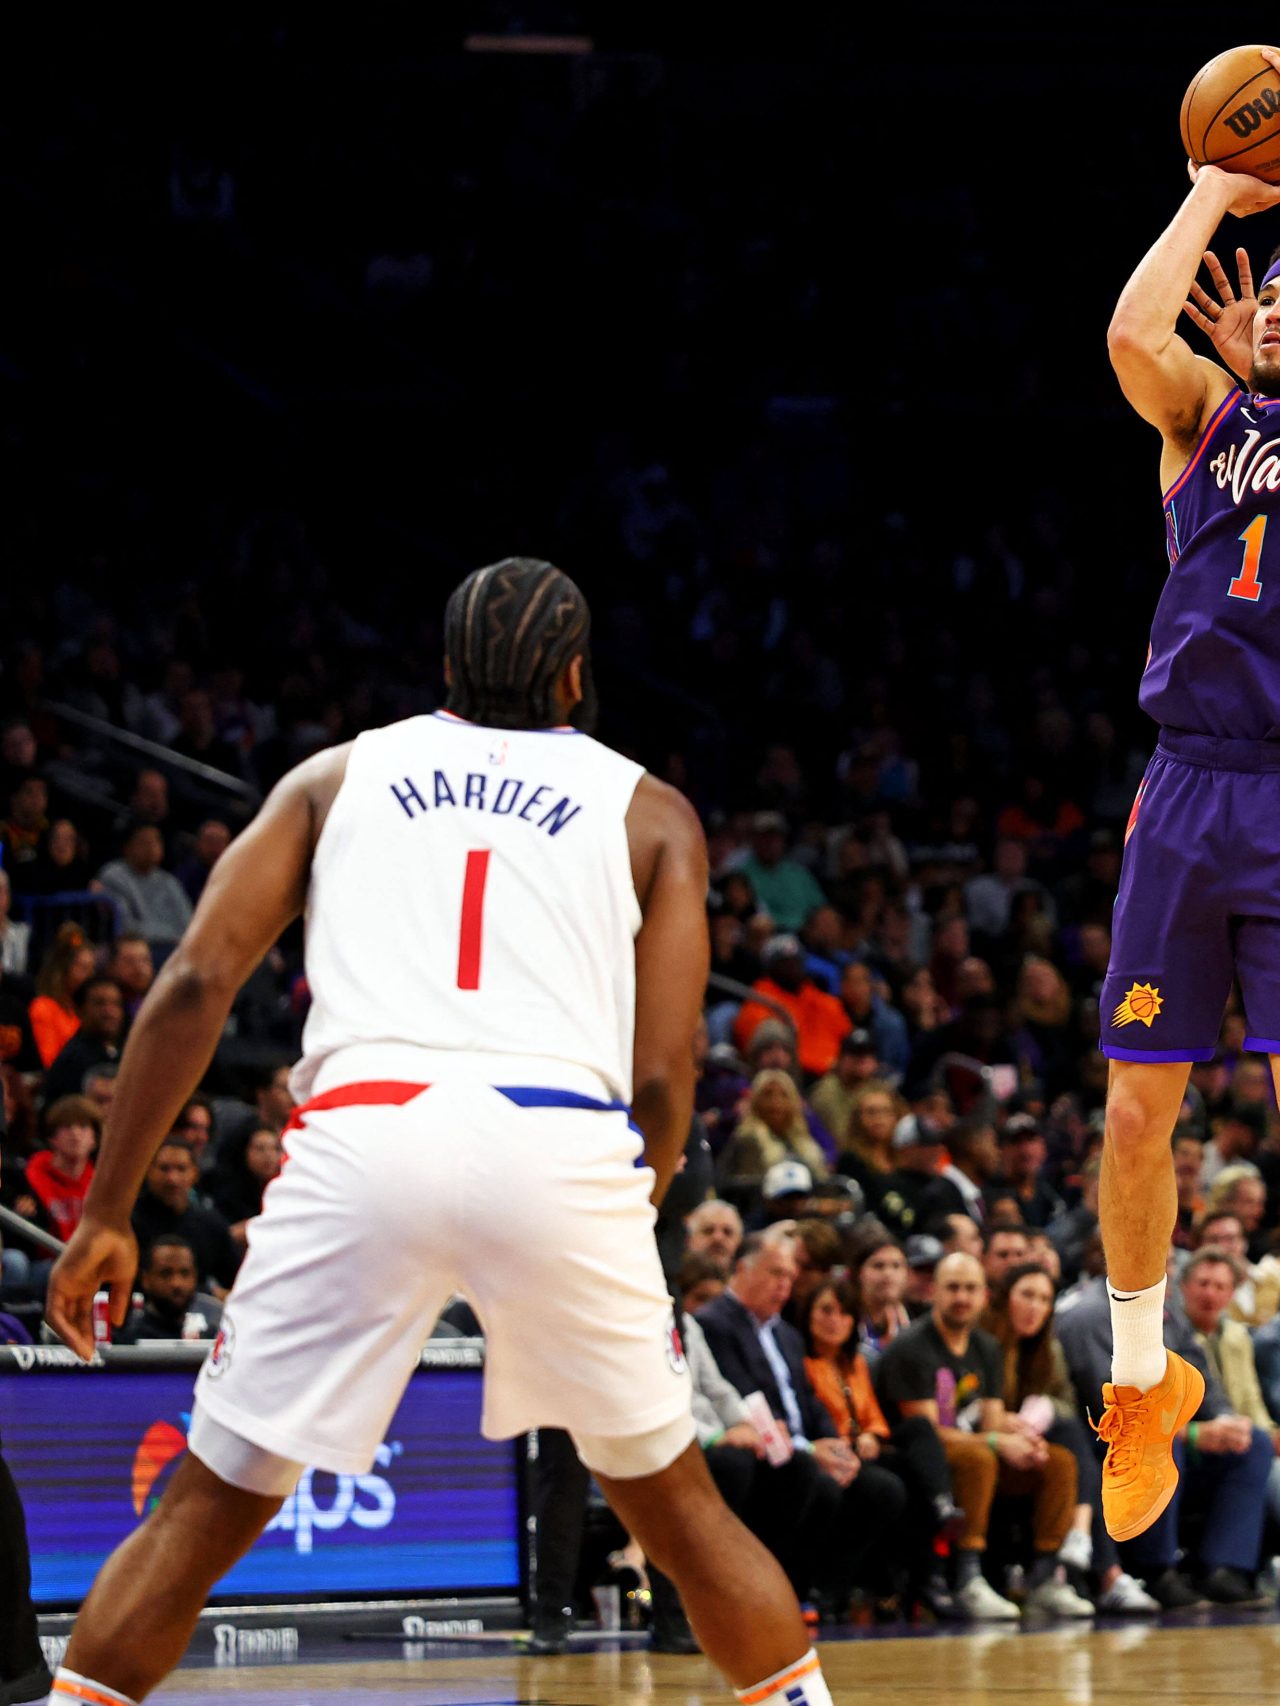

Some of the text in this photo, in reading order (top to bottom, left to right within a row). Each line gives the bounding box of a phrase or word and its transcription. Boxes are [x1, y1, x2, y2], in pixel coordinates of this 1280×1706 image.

[1227, 514, 1268, 601] 1
[390, 769, 582, 836] HARDEN
[457, 849, 491, 990] 1
